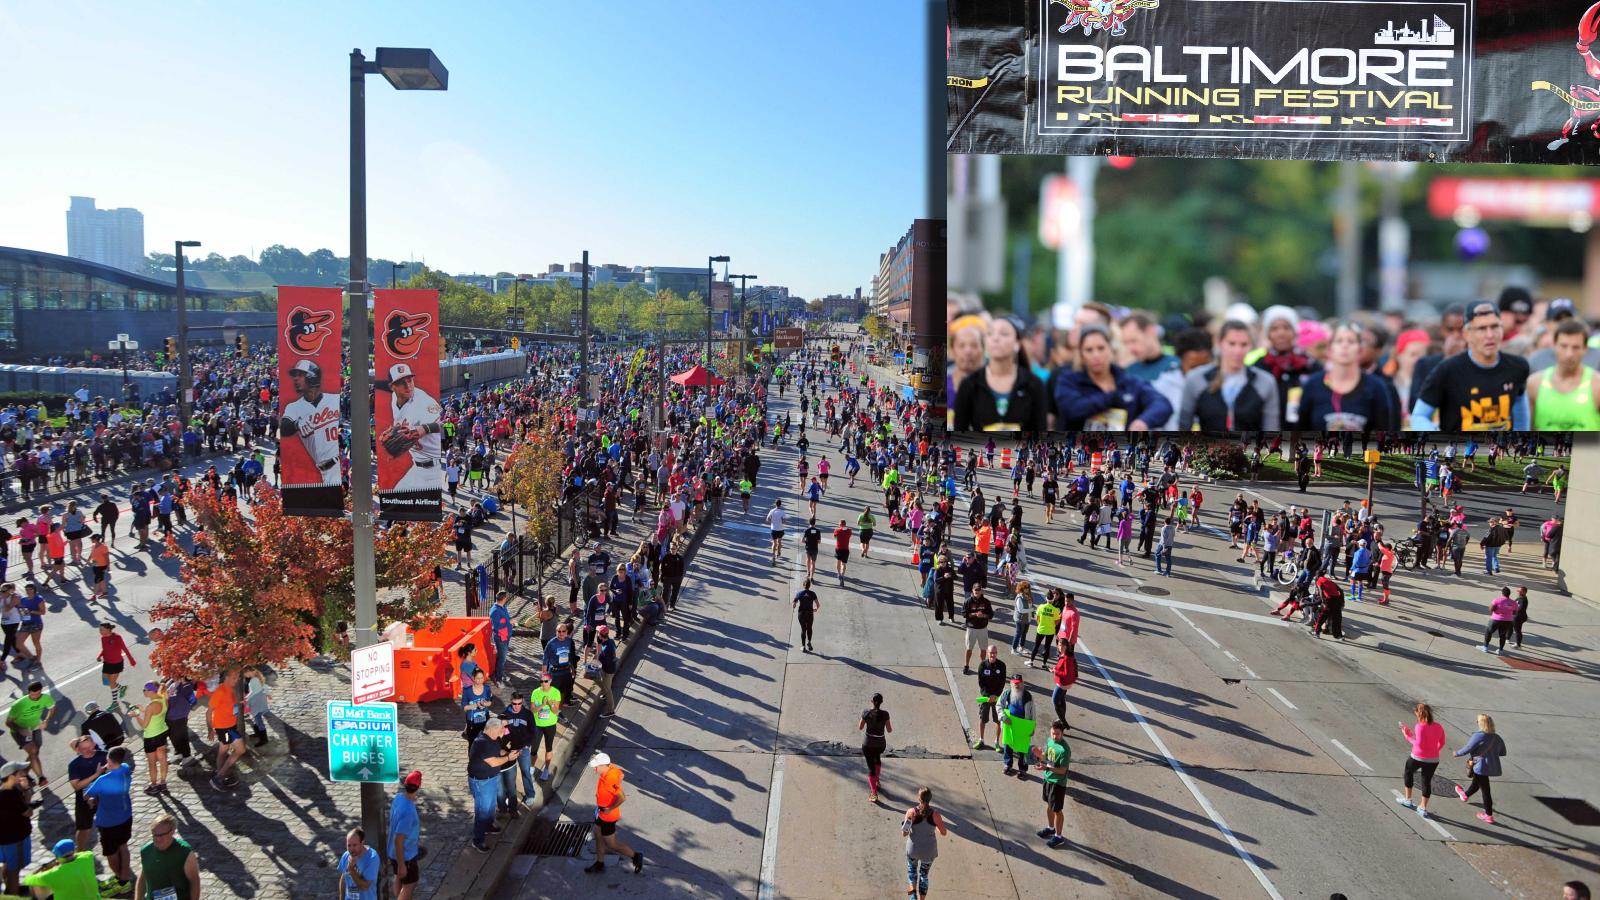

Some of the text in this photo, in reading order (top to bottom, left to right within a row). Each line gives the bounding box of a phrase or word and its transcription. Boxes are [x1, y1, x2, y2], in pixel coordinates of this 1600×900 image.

[1058, 44, 1454, 87] BALTIMORE
[1057, 86, 1453, 110] RUNNING FESTIVAL
[325, 426, 339, 442] 10
[381, 497, 440, 506] Southwest Airlines
[368, 651, 378, 662] NO
[356, 664, 390, 680] STOPPING
[345, 709, 392, 720] M&T Bank
[332, 733, 393, 748] CHARTER
[342, 751, 385, 765] BUSES
